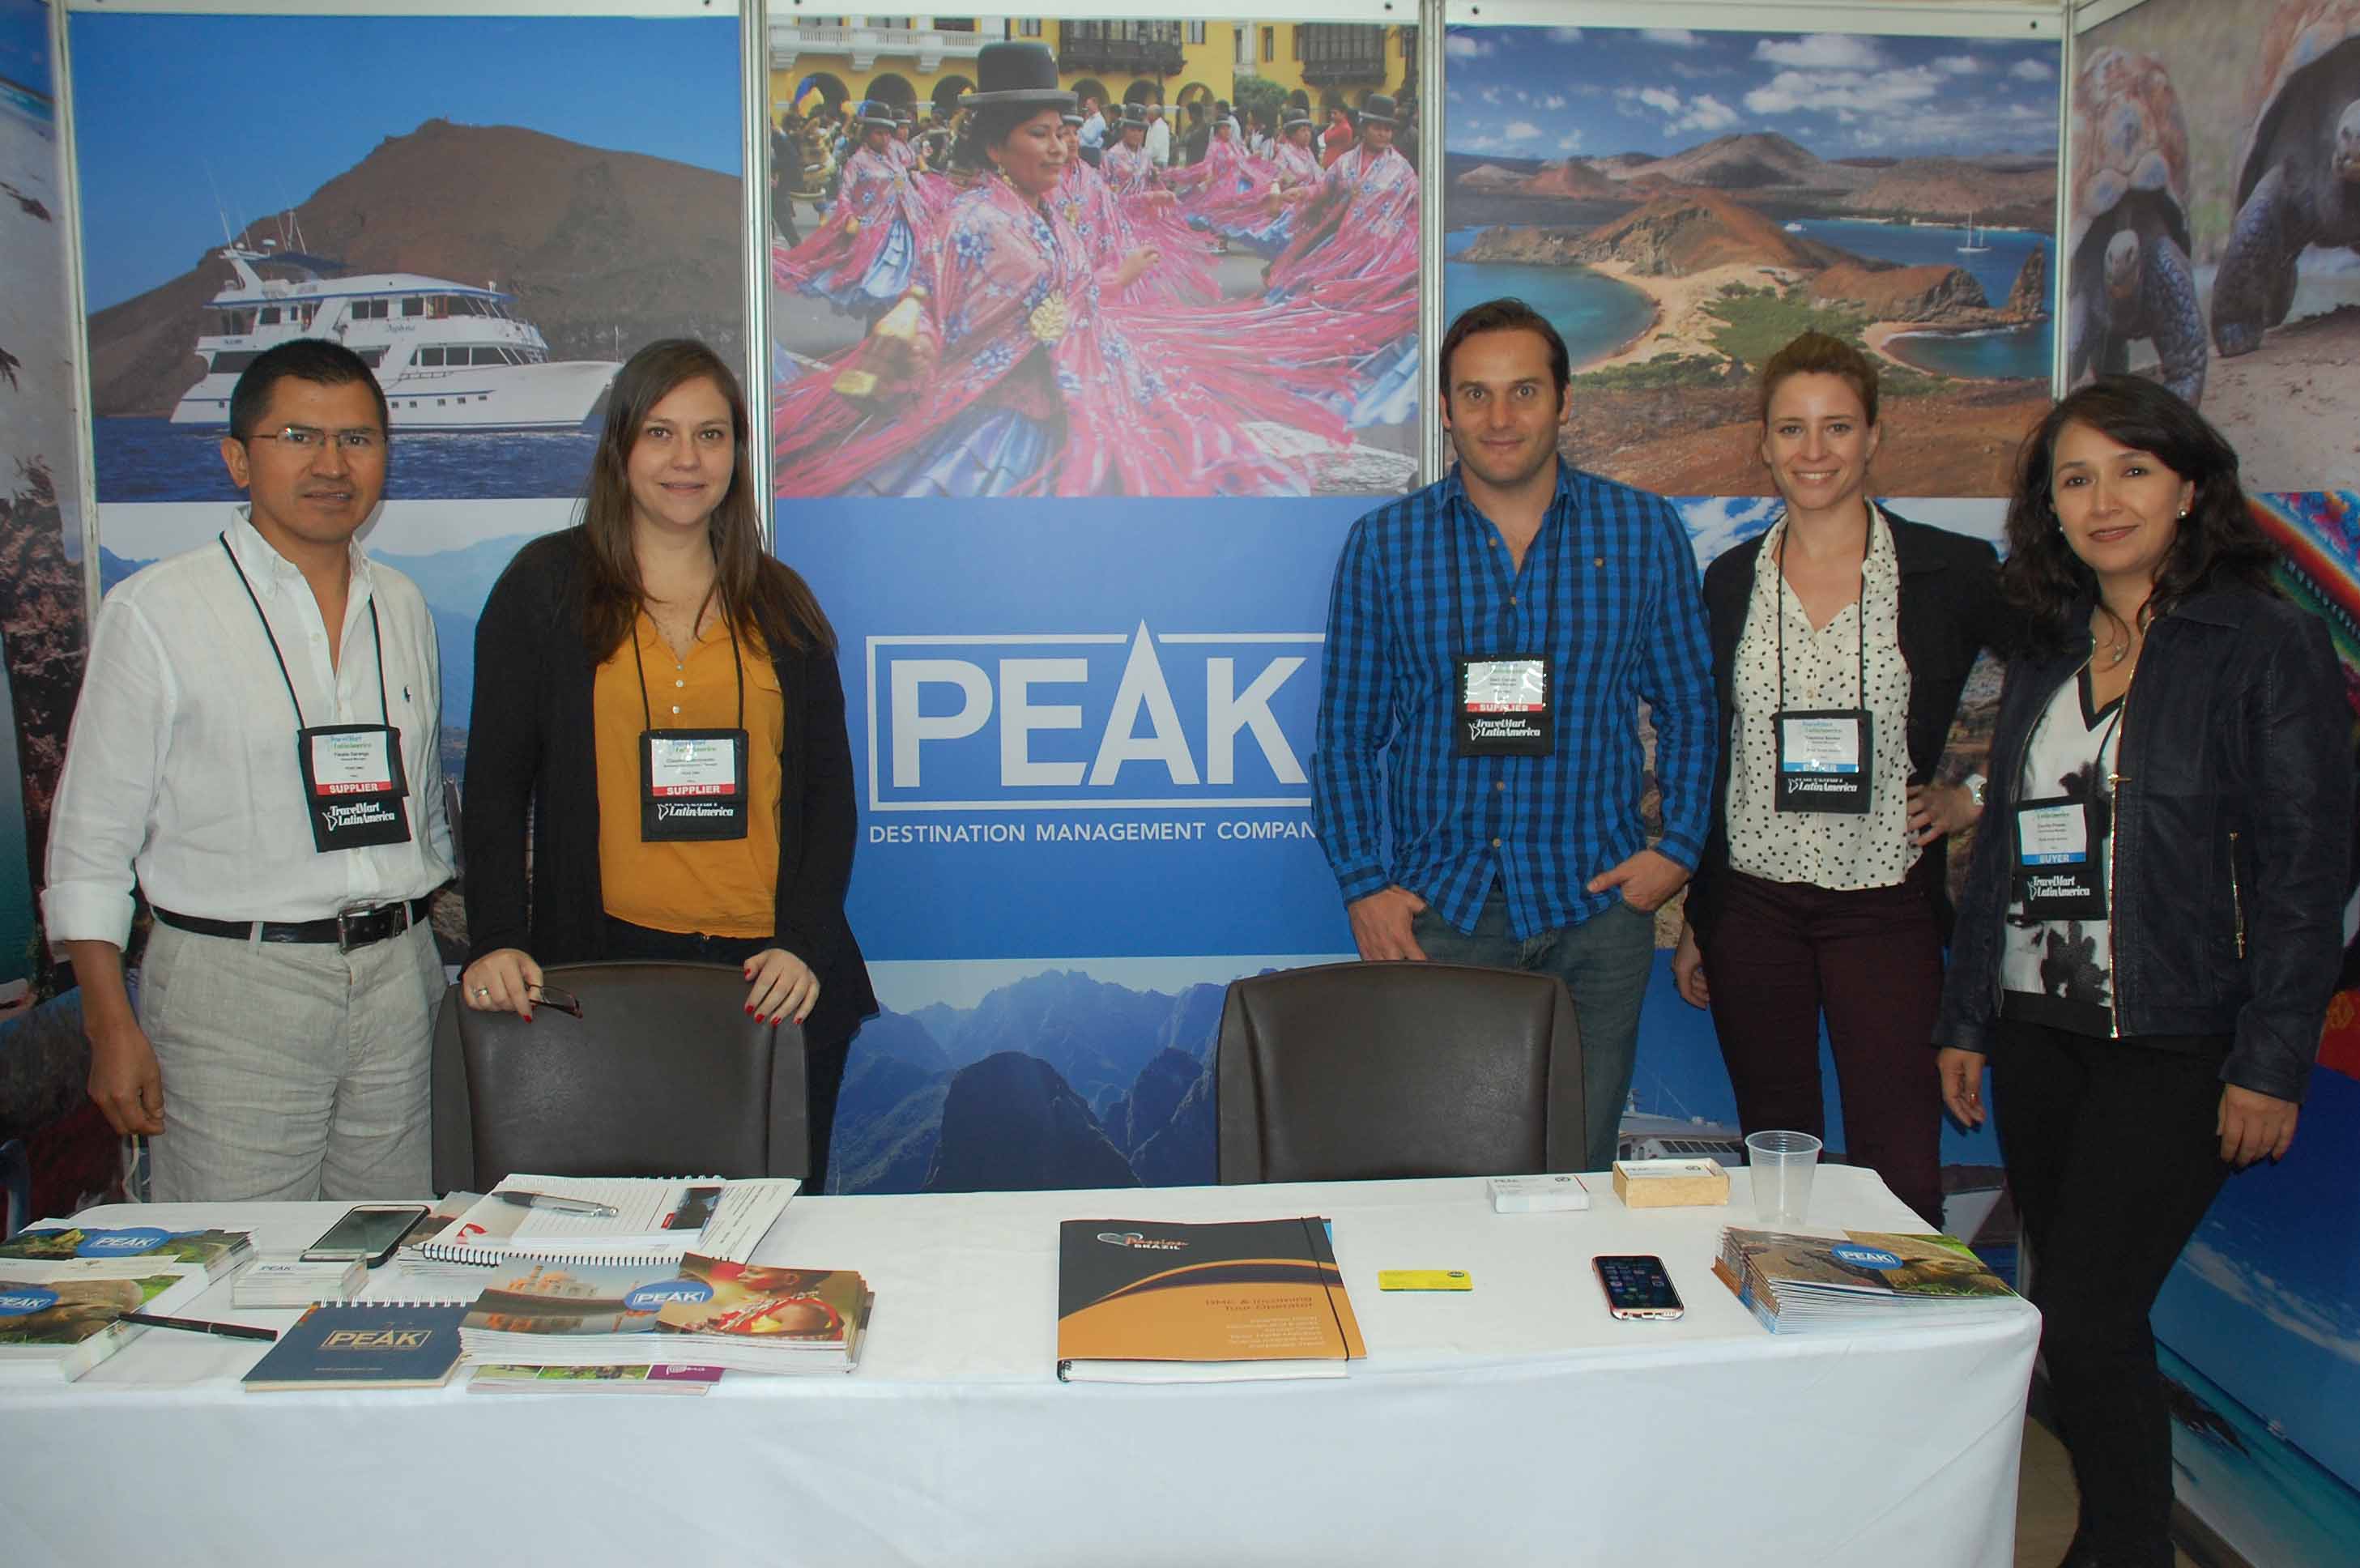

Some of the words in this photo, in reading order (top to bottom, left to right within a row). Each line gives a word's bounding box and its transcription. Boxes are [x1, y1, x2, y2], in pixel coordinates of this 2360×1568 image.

[891, 618, 1309, 787] PEAK
[1476, 719, 1527, 728] TravelMart
[1480, 726, 1540, 737] LatinAmerica
[329, 783, 379, 794] SUPPLIER
[667, 786, 720, 795] SUPPLIER
[1798, 782, 1859, 793] LatinAmerica
[330, 802, 380, 816] TravelMart
[669, 806, 734, 816] LatinAmerica
[338, 811, 395, 826] LatinAmerica
[869, 824, 1025, 843] DESTINATION
[1036, 822, 1207, 842] MANAGEMENT
[1216, 820, 1317, 839] COMPAN
[2039, 854, 2070, 864] BUYER
[2033, 875, 2076, 887] TravelMart
[2037, 885, 2091, 897] LatinAmerica
[96, 1237, 155, 1247] PEAK
[1841, 1251, 1893, 1264] PEAK
[636, 1290, 699, 1303] PEAK
[327, 1330, 422, 1347] PEAK
